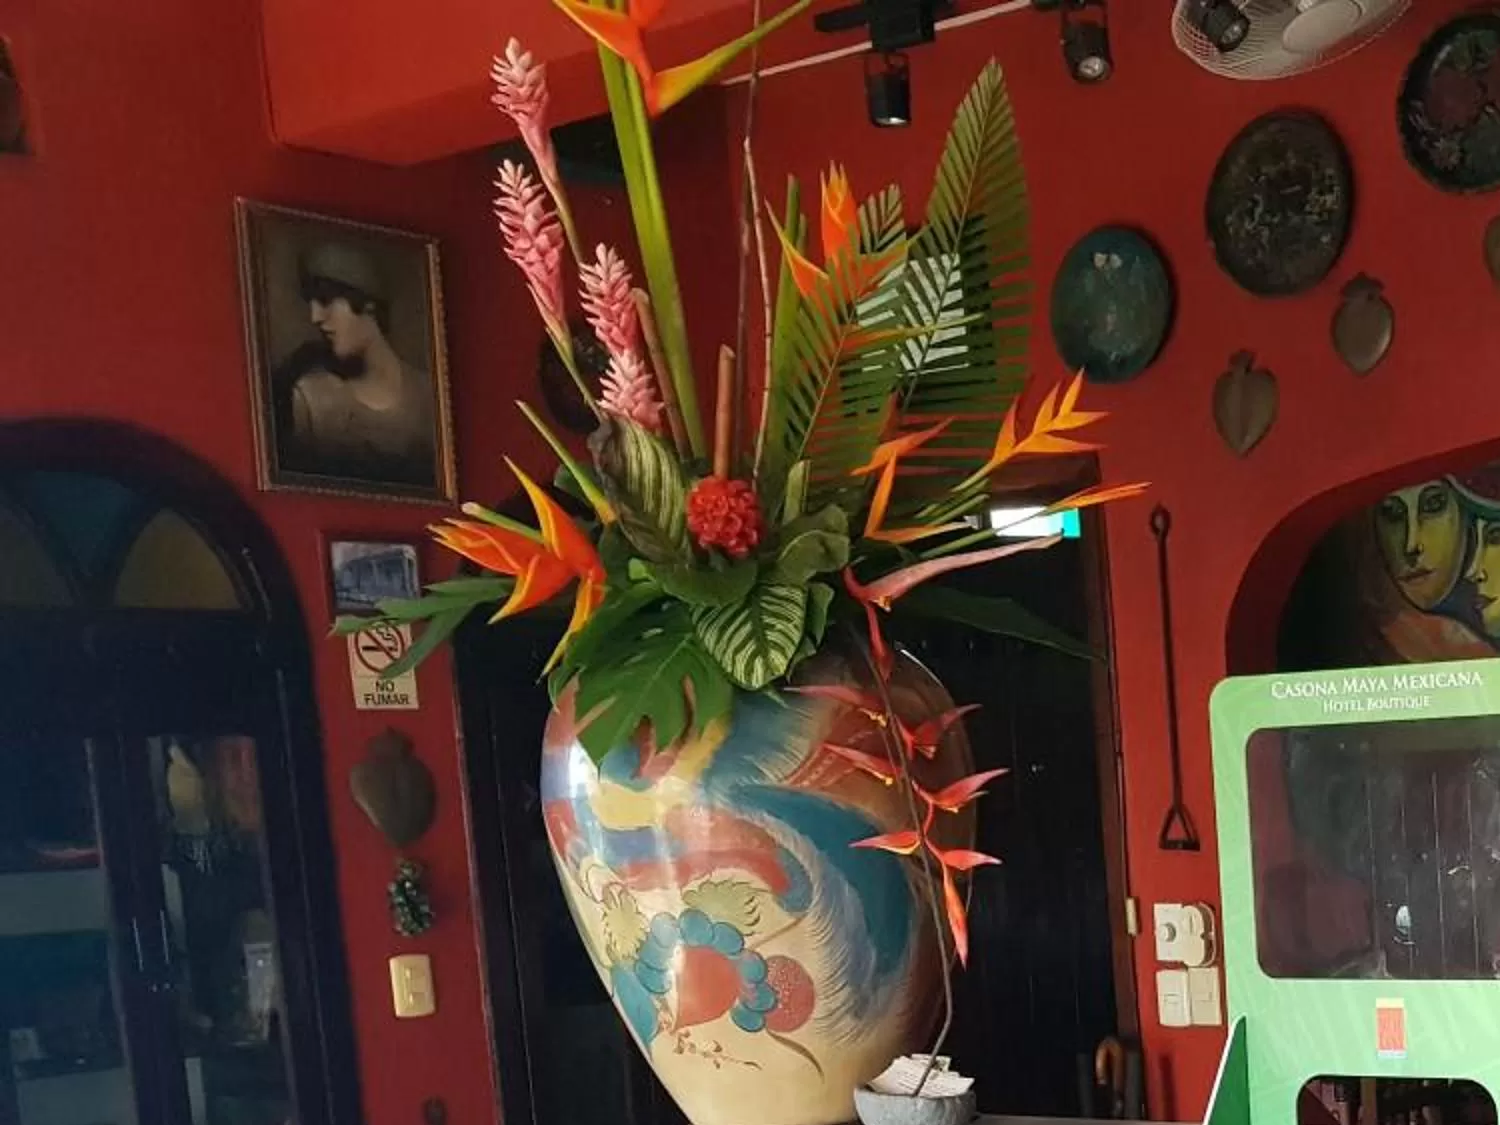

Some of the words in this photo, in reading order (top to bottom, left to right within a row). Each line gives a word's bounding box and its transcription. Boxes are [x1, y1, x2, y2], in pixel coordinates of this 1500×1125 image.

[375, 680, 395, 692] NO
[1271, 681, 1338, 698] CASONA
[1342, 676, 1389, 695] MAYA
[1392, 671, 1484, 690] MEXICANA
[363, 692, 410, 705] FUMAR
[1323, 699, 1364, 713] HOTEL
[1367, 695, 1431, 712] BOUTIQUE
